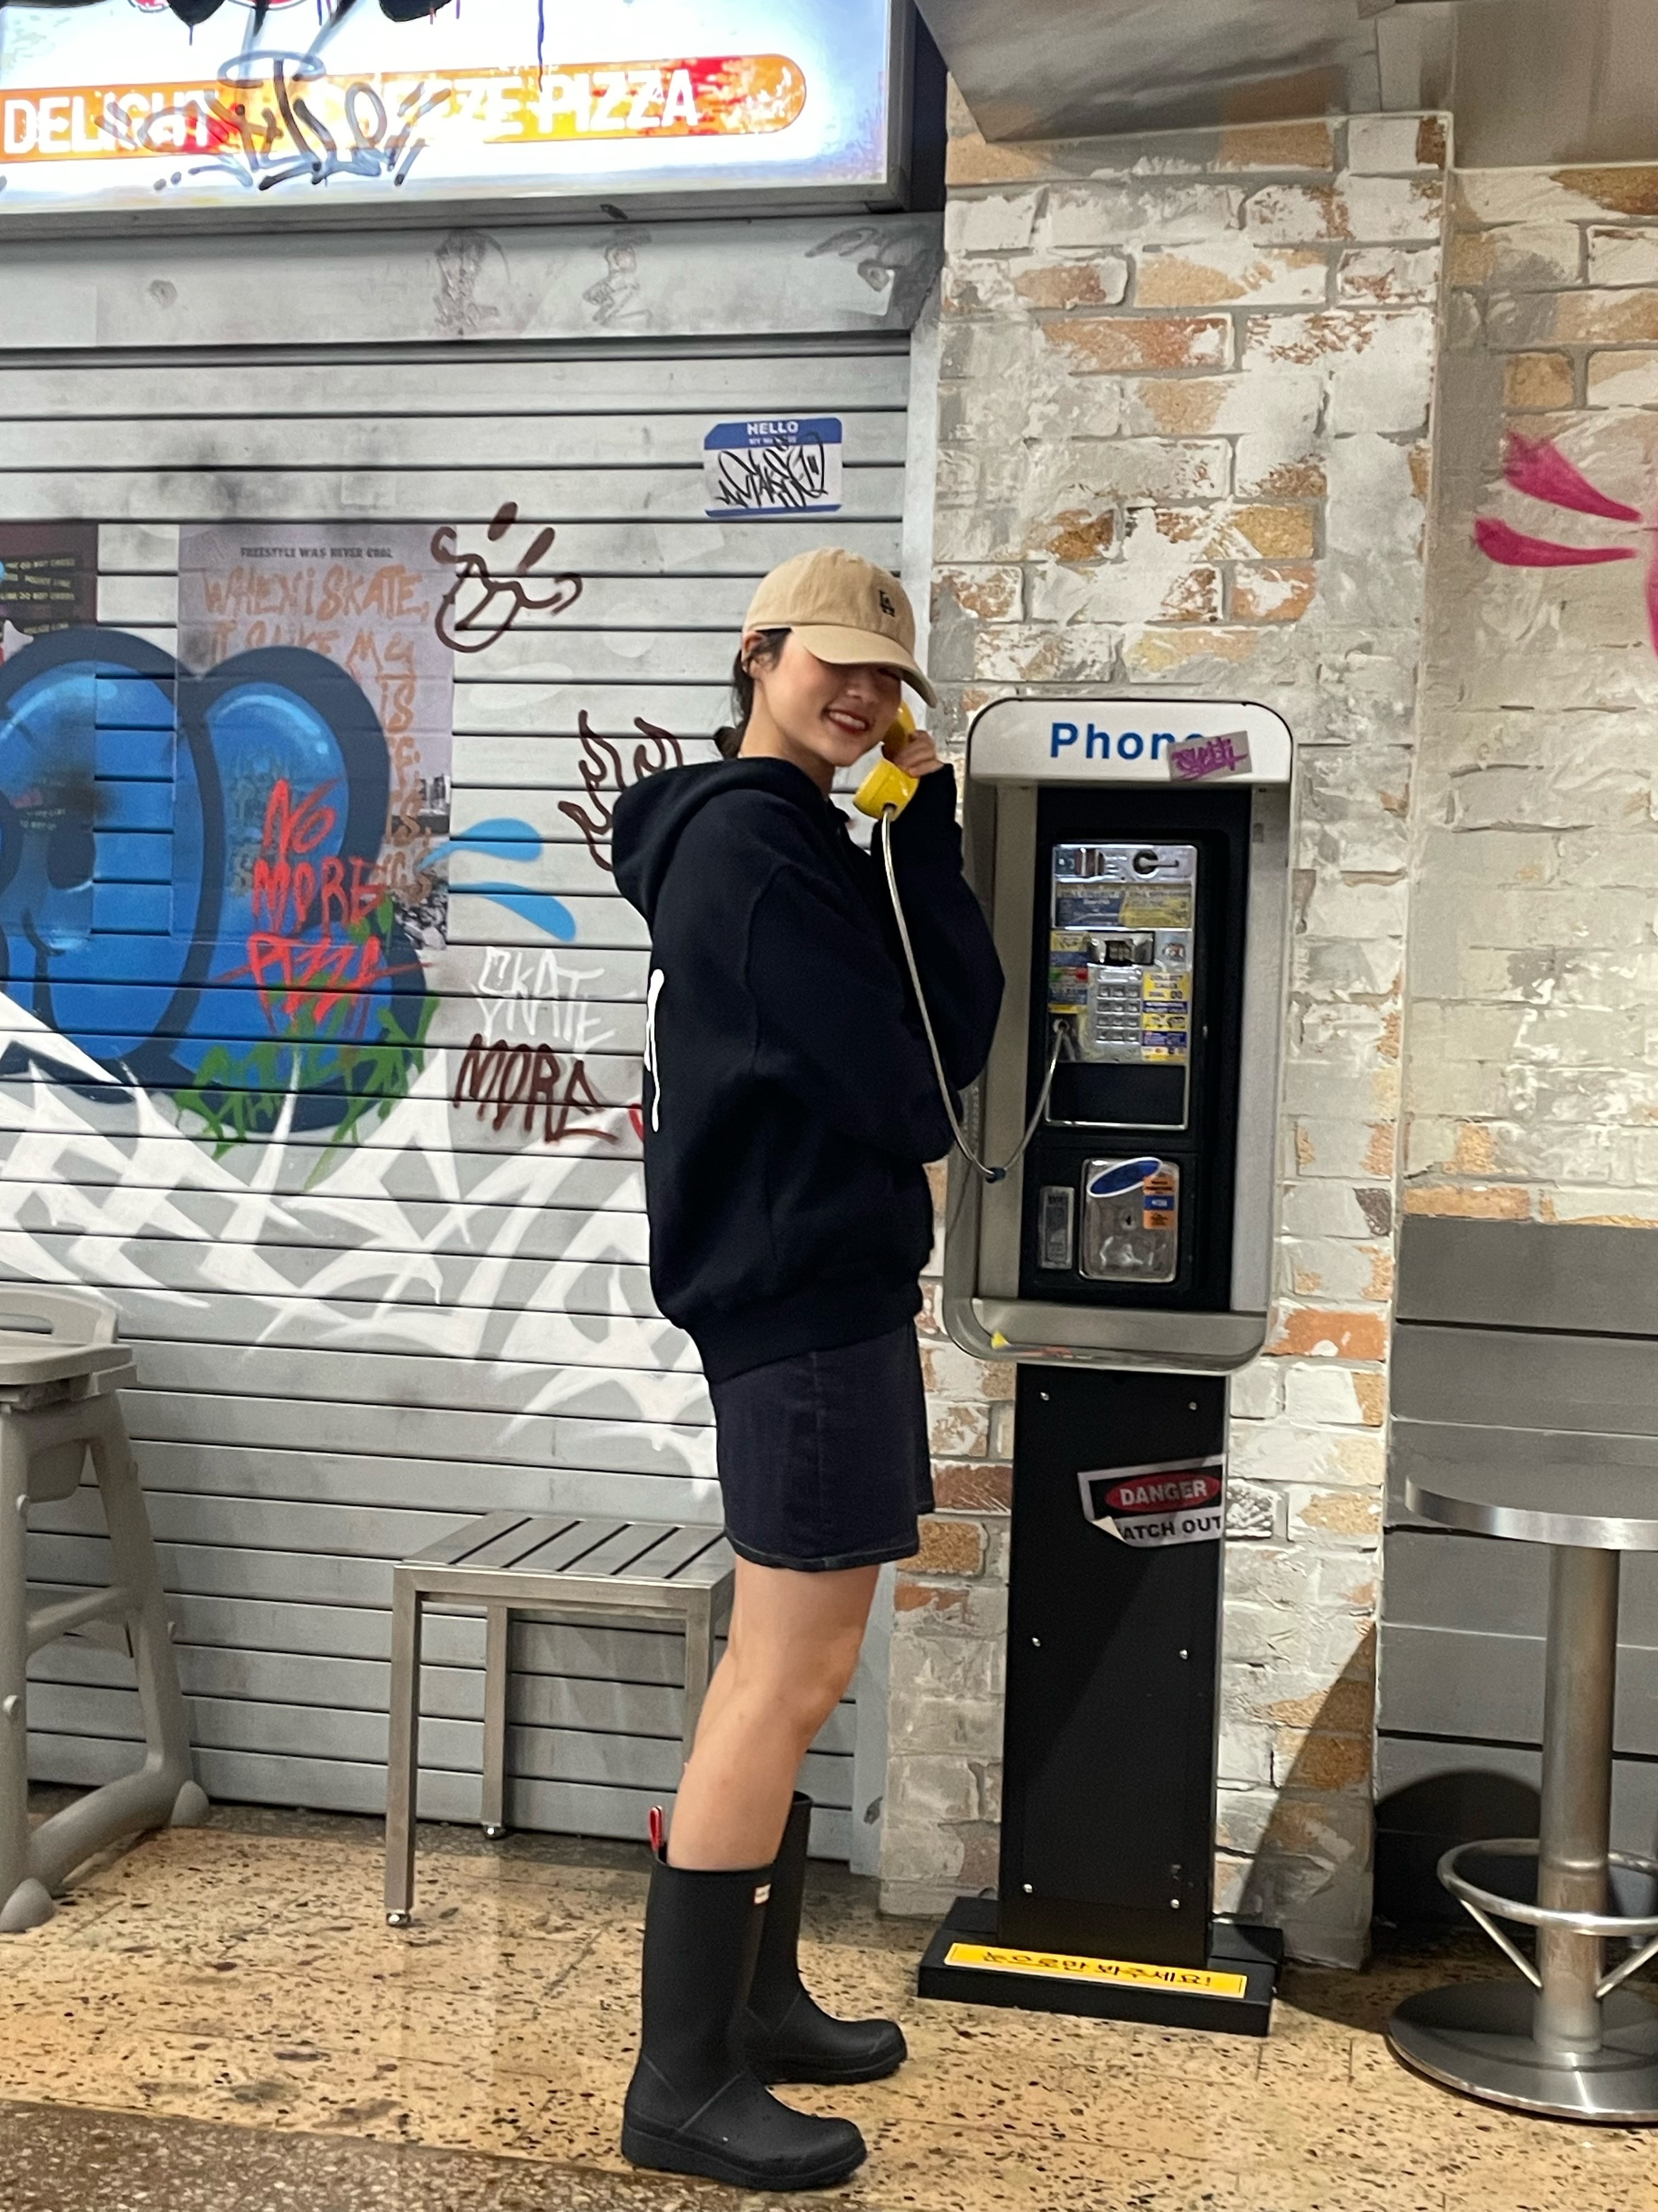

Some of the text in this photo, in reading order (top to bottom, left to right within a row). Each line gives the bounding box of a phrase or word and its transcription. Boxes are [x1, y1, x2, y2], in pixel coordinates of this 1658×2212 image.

[537, 68, 700, 134] PIZZA
[747, 421, 798, 435] HELLO
[298, 548, 326, 558] WAS
[1050, 722, 1204, 760] Phon
[262, 777, 340, 859] NO
[252, 856, 386, 932] MORE
[1120, 1480, 1207, 1505] DANGER
[1118, 1521, 1175, 1540] ATCH
